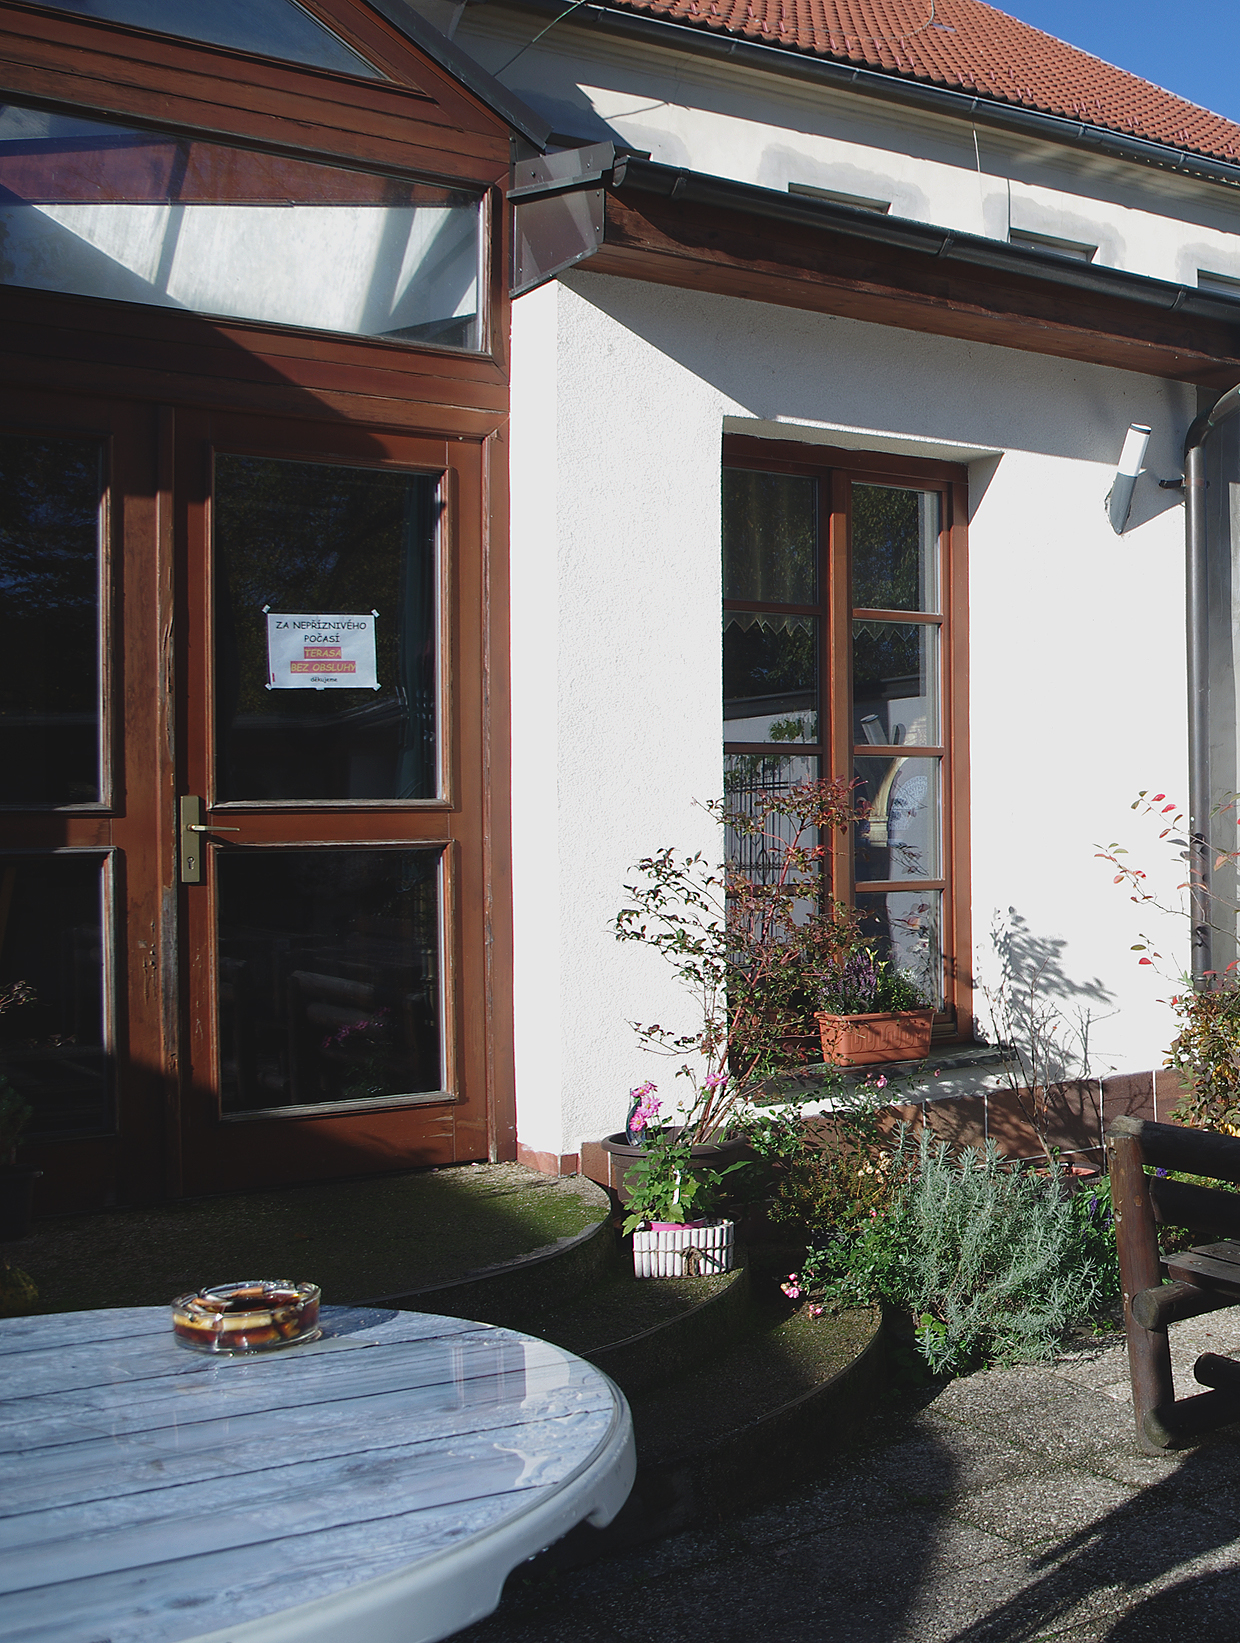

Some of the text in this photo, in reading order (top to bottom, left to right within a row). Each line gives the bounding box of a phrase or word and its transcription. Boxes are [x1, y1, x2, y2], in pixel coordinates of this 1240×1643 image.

[276, 619, 367, 630] ZA NEPŘÍZNIVÉHO
[304, 633, 340, 643] POČASÍ
[305, 649, 341, 657] TERASA
[291, 663, 356, 672] BEZ OBSLUHY
